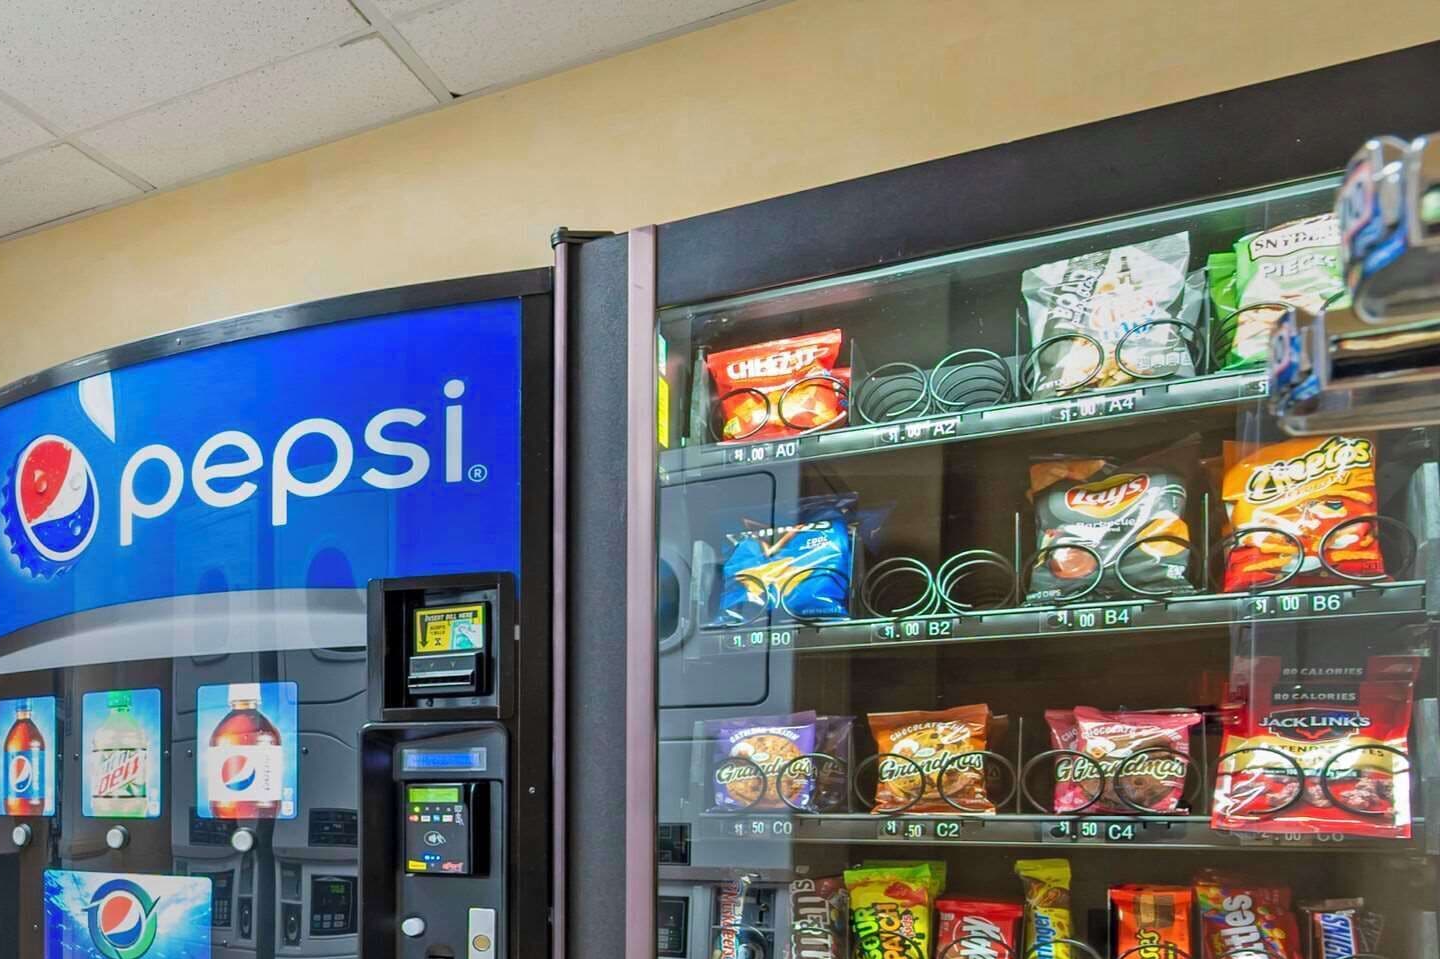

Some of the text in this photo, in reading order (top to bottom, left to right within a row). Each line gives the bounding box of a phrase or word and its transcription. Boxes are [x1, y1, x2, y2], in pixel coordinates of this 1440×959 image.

[1110, 398, 1133, 411] A4
[933, 423, 955, 436] A2
[776, 445, 796, 457] A0
[119, 379, 463, 546] pepsi
[1313, 595, 1341, 610] B6
[1105, 609, 1129, 624] B4
[929, 622, 950, 636] B2
[771, 631, 791, 645] B0
[1301, 667, 1363, 676] CALORIES
[1291, 692, 1357, 700] CALORIES
[1258, 716, 1308, 728] JACK
[773, 821, 792, 834] C0
[937, 823, 959, 837] C2
[1109, 825, 1134, 839] C4
